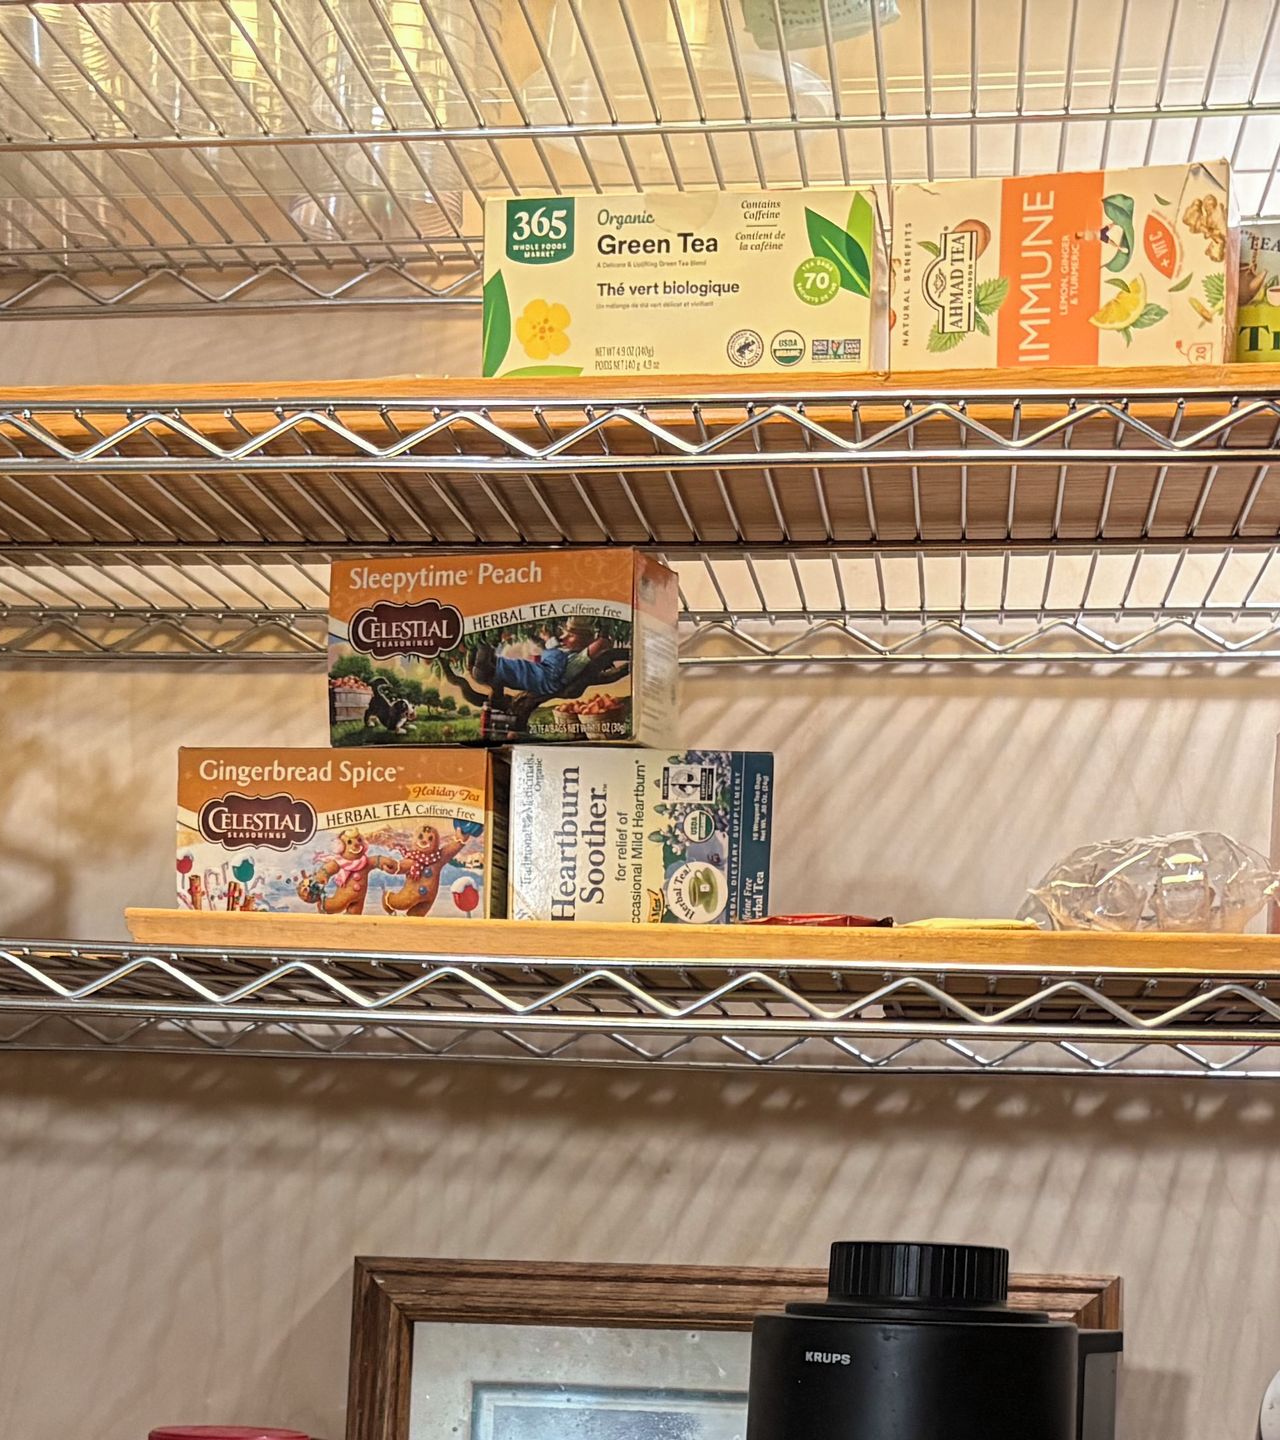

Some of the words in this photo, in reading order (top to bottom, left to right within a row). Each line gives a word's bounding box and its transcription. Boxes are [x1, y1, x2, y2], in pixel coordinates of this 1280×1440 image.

[741, 200, 781, 209] Contains
[743, 209, 780, 220] Caffeine
[512, 206, 568, 241] 365
[597, 209, 655, 230] Organic
[597, 233, 671, 255] Green
[677, 232, 718, 253] Tea
[735, 232, 773, 241] Contient
[774, 230, 786, 240] de
[739, 241, 748, 251] la
[750, 240, 783, 252] caféine
[512, 243, 539, 252] WHOLE
[541, 242, 567, 250] FOODS
[524, 250, 555, 258] MARKET
[905, 222, 913, 281] BENEFITS
[950, 235, 965, 266] TEA
[1061, 235, 1070, 274] GINGER
[1018, 190, 1055, 362] IMMUNE
[1070, 243, 1080, 296] TURMERIC
[597, 282, 625, 296] Thé
[629, 282, 659, 295] vert
[663, 280, 740, 297] biologique
[804, 272, 830, 290] 70
[949, 269, 964, 329] AHMAD
[902, 290, 912, 346] NATURAL
[595, 347, 606, 356] NET
[607, 346, 615, 356] WT
[779, 339, 797, 347] USDA
[1196, 346, 1206, 361] 20
[595, 360, 612, 370] POIDS
[613, 360, 624, 369] NET
[349, 564, 468, 594] Sleepytime
[477, 560, 543, 585] Peach
[472, 609, 527, 631] HERBAL
[530, 603, 558, 617] TEA
[561, 603, 601, 616] Caffeine
[603, 605, 622, 618] Free
[357, 615, 454, 643] CELESTIAL
[376, 639, 435, 648] SEASONINGS
[536, 724, 549, 734] TEA
[199, 759, 332, 786] Gingerbread
[339, 761, 397, 789] Spice
[533, 758, 543, 792] Organic
[754, 773, 762, 790] Bags
[412, 785, 458, 800] Holiday
[460, 789, 480, 802] Tea
[733, 771, 741, 838] SUPPLEMENT
[753, 790, 761, 802] Tea
[208, 807, 307, 833] CELESTIAL
[326, 806, 381, 827] HERBAL
[384, 803, 411, 817] TEA
[416, 804, 454, 817] Caffeine
[457, 807, 475, 820] Free
[617, 812, 628, 825] of
[690, 816, 698, 835] USDA
[753, 803, 761, 832] Wrapped
[227, 831, 287, 840] SEASONINGS
[551, 766, 580, 921] Heartburn
[579, 787, 608, 904] Soother
[617, 827, 628, 858] relief
[631, 830, 643, 860] Mild
[615, 864, 626, 881] for
[731, 842, 739, 886] DIETARY
[744, 877, 752, 897] Free
[753, 871, 765, 893] Tea
[631, 863, 642, 924] ccasional
[673, 888, 695, 920] Herbal
[804, 1351, 852, 1366] KRUPS
